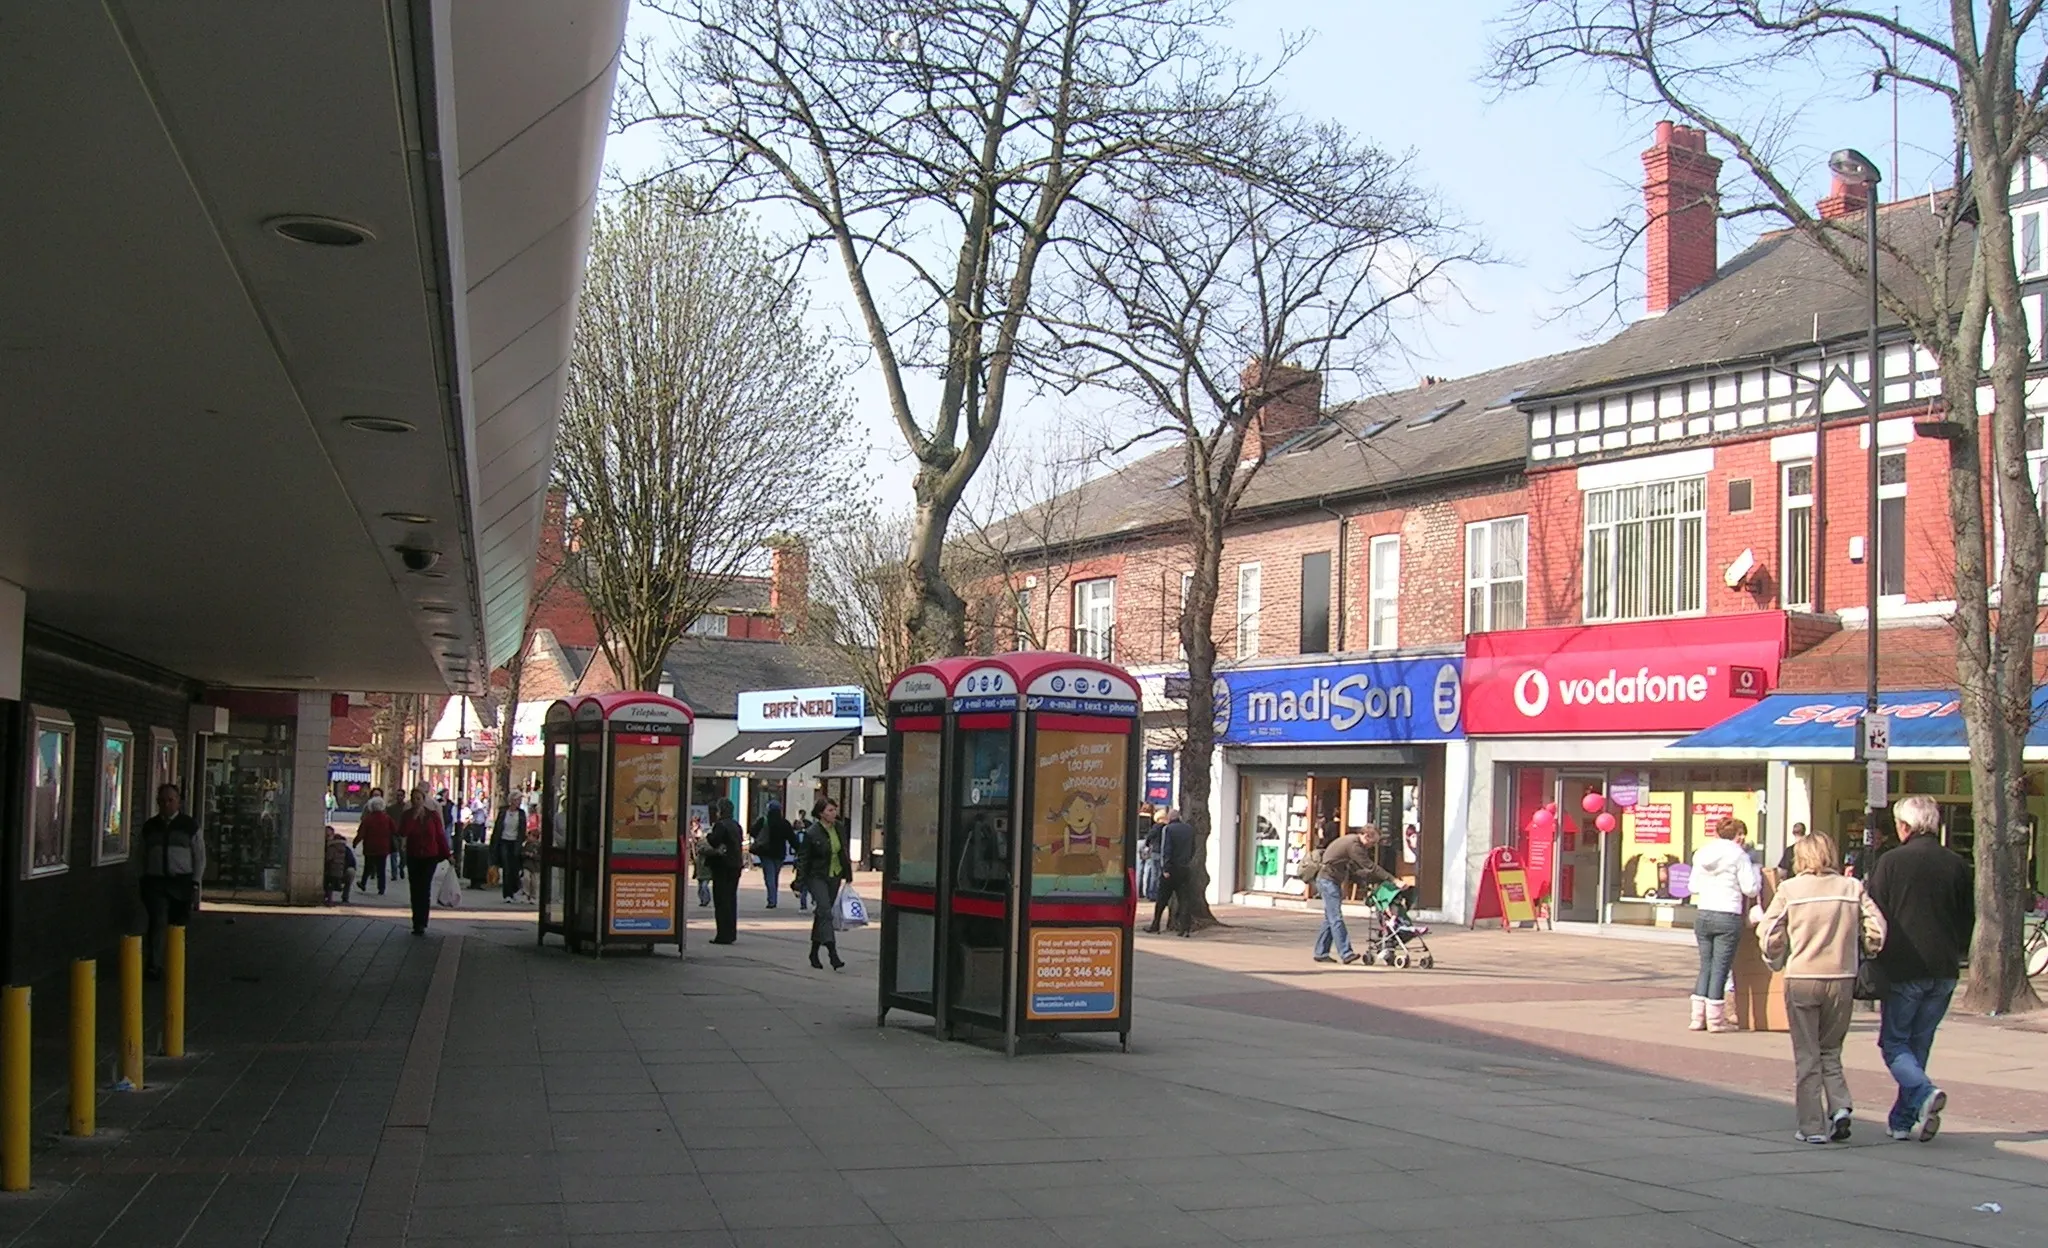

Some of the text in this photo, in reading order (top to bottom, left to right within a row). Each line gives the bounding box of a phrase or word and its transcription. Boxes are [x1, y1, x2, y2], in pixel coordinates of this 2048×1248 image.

[1559, 666, 1708, 705] vodafone
[800, 699, 834, 718] NERO
[965, 697, 1017, 709] e-mail text phone
[1049, 699, 1136, 713] e-mail text phone
[631, 708, 669, 719] Telephone
[616, 899, 634, 908] 0800
[1037, 966, 1113, 978] 0800 2 346 346
